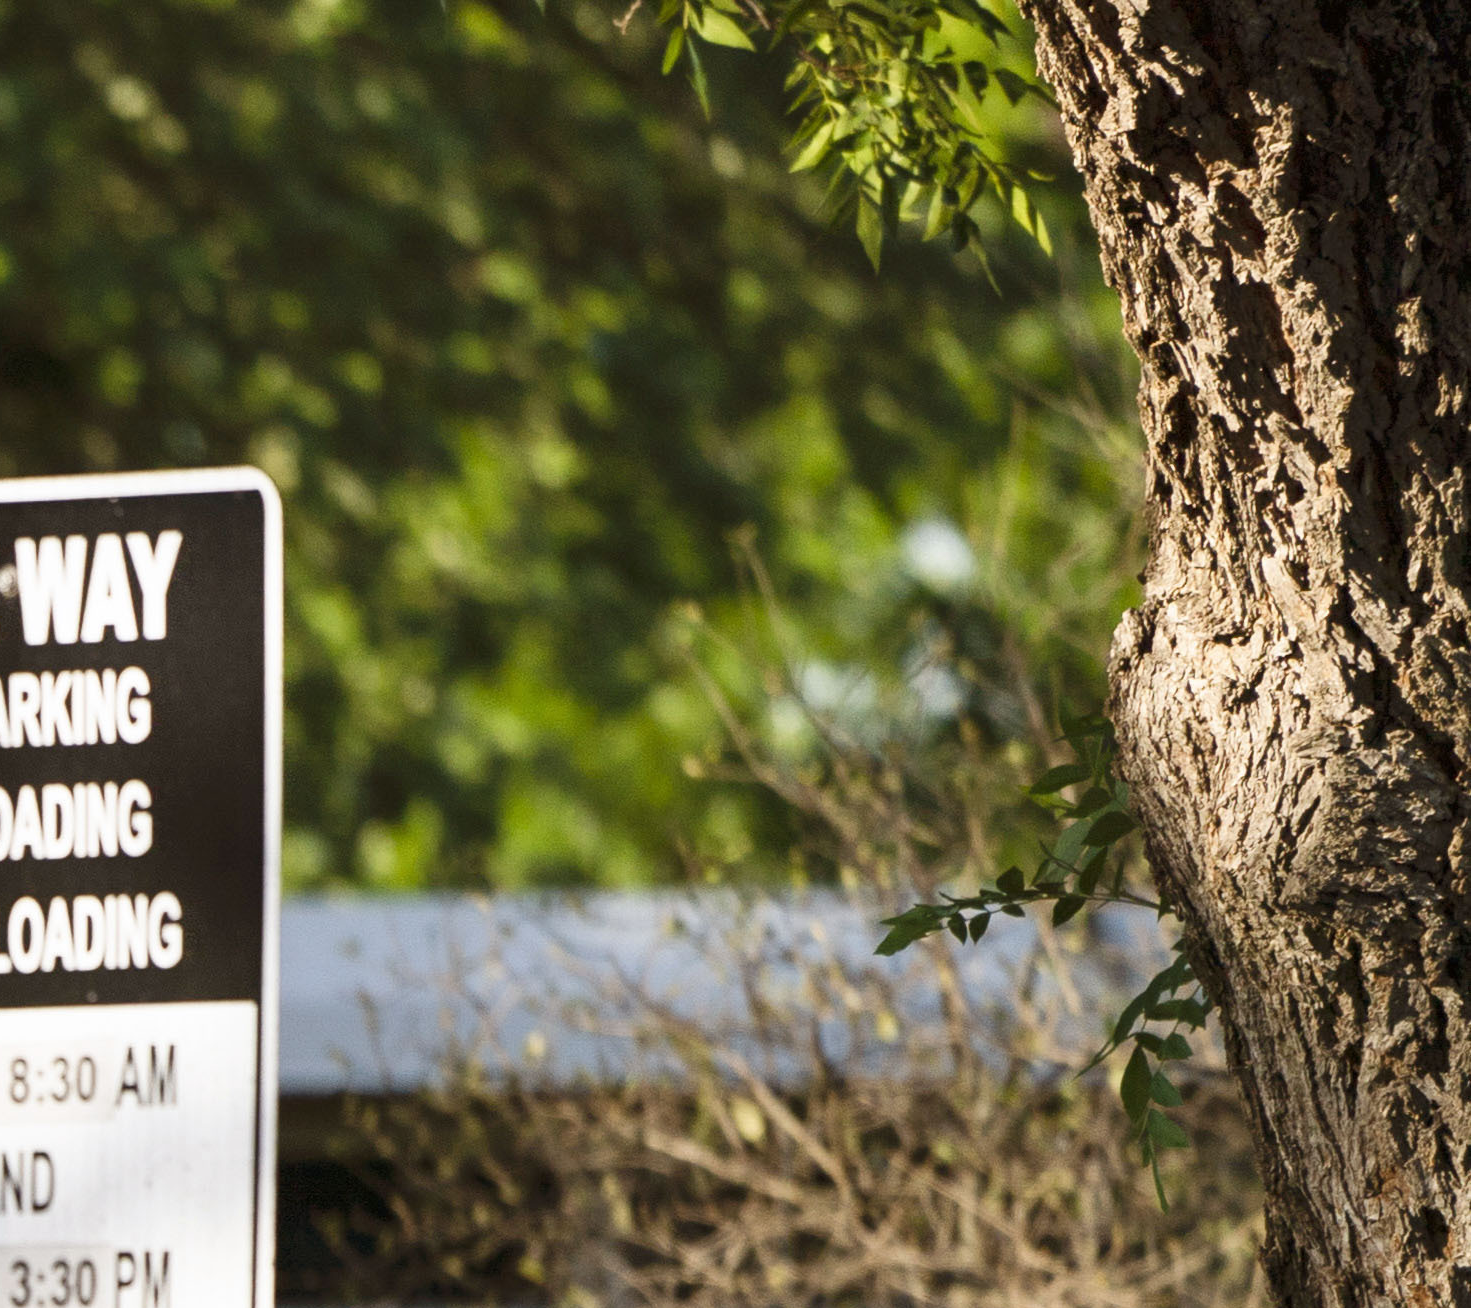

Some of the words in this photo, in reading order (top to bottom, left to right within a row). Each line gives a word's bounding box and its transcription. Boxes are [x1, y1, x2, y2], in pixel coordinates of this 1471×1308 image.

[15, 530, 183, 645] WAY
[9, 1055, 97, 1105] 8:30
[115, 1044, 178, 1108] AM
[9, 1258, 98, 1308] 3:30
